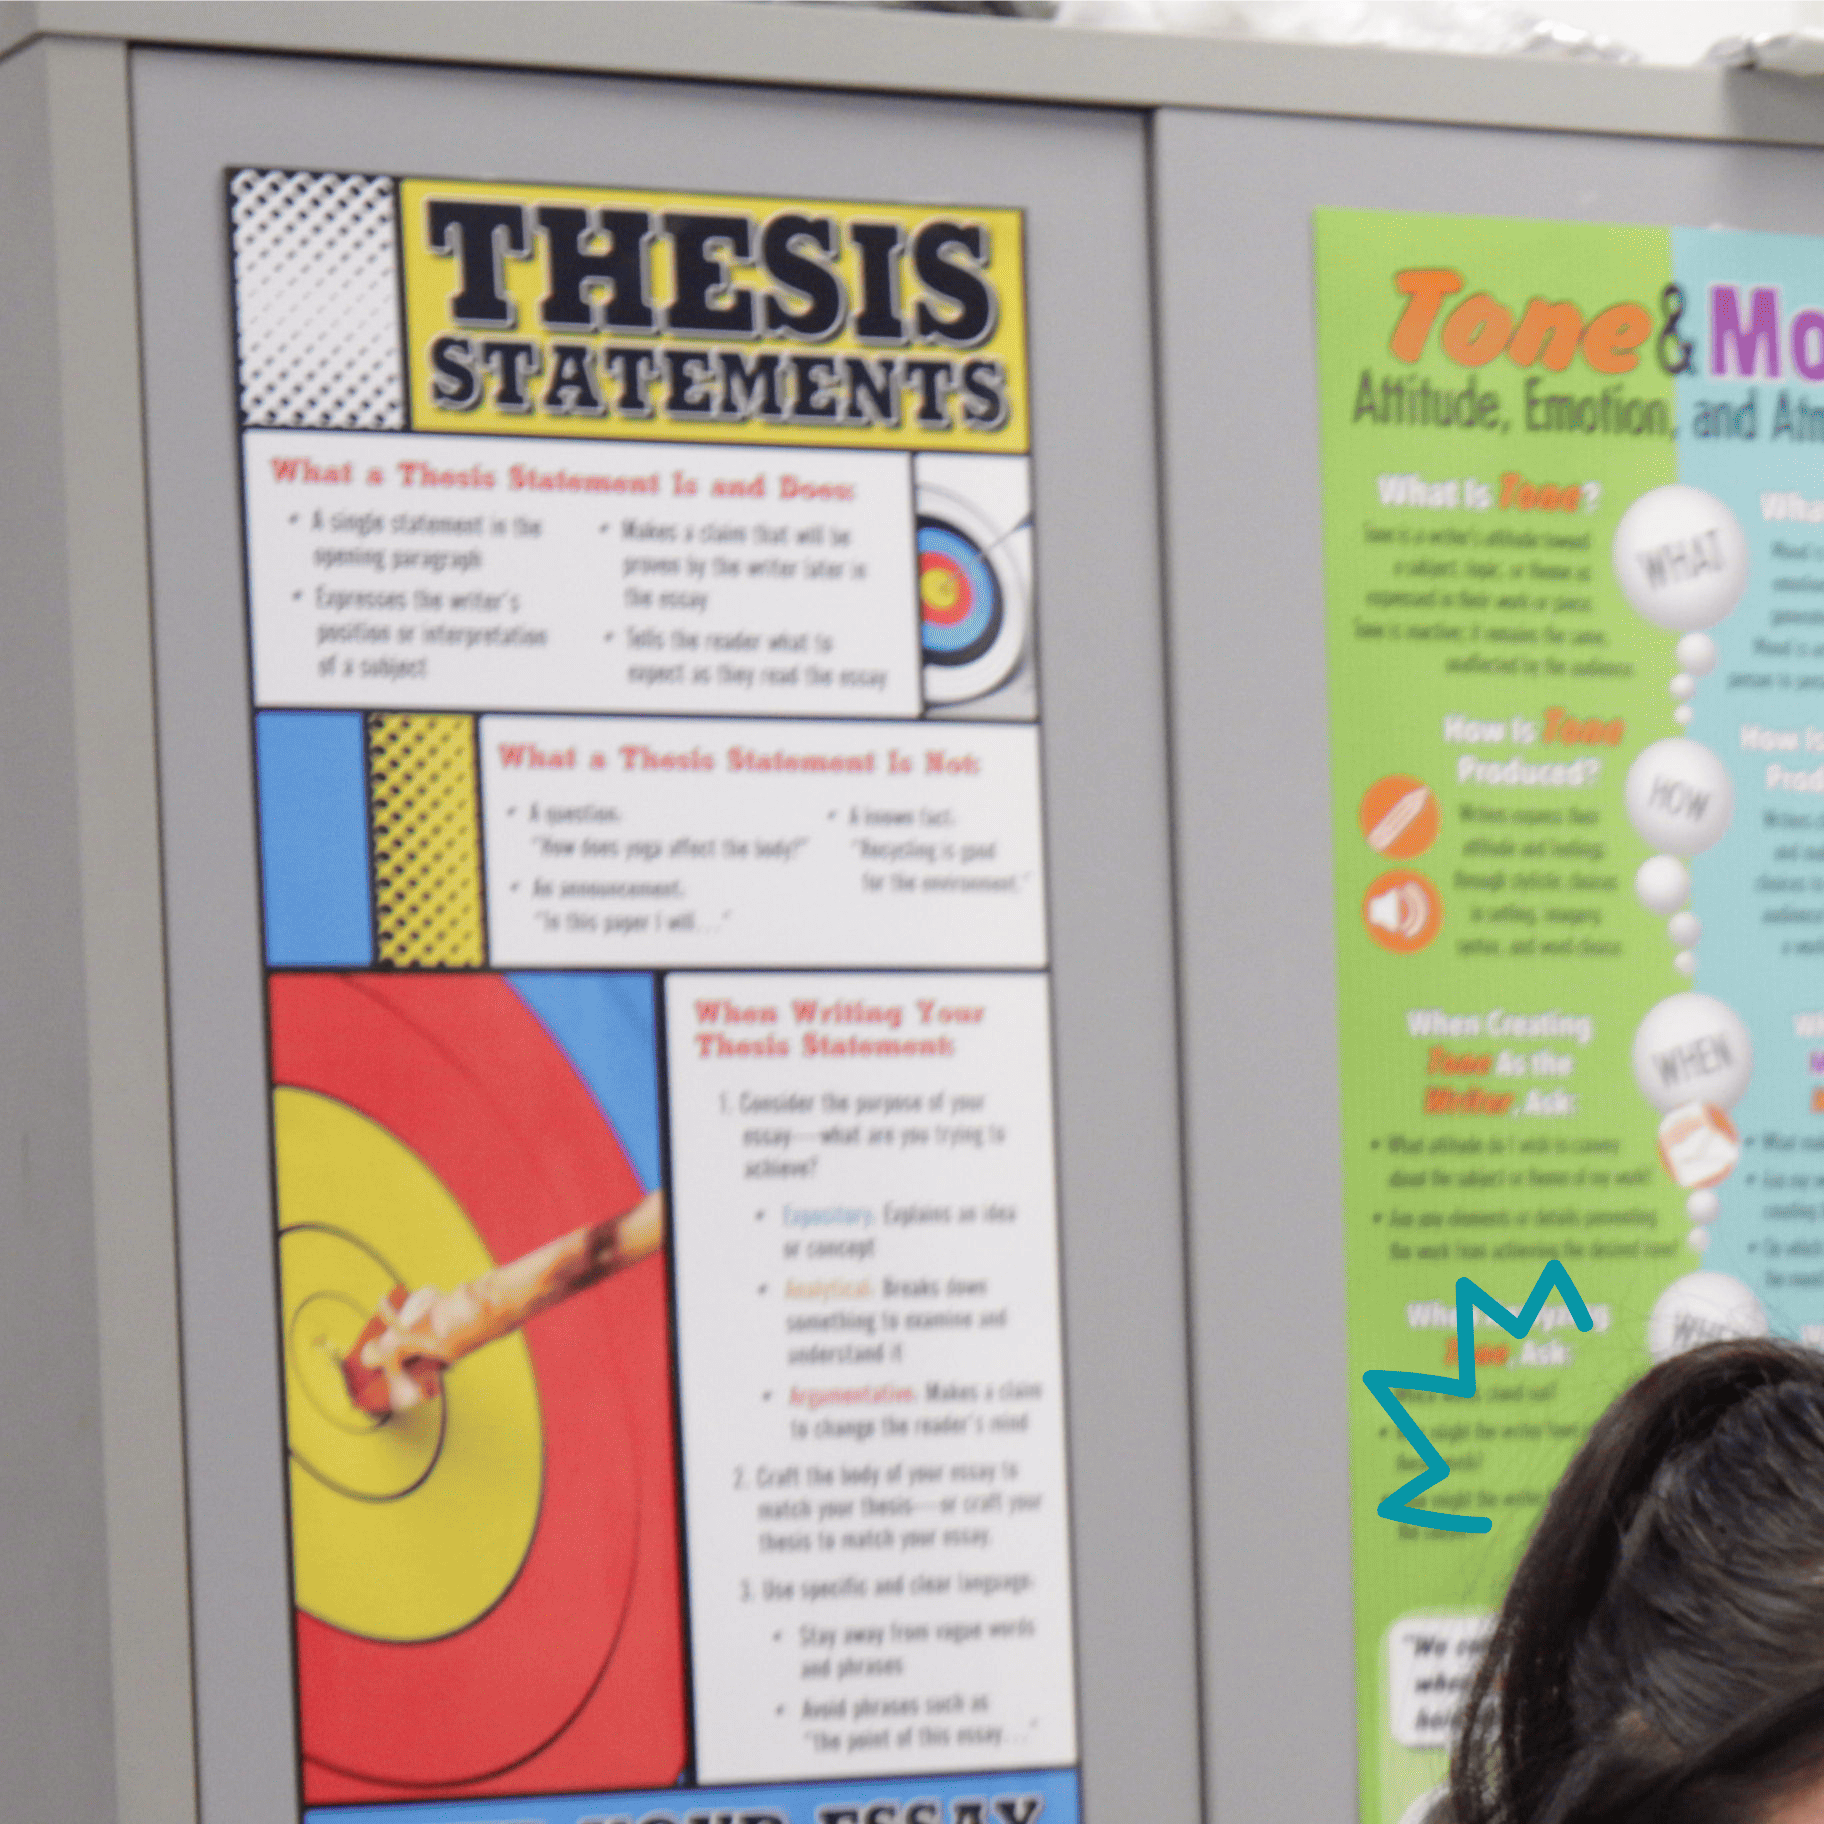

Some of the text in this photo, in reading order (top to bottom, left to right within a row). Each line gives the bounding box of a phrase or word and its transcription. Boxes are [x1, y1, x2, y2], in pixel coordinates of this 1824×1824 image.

[425, 198, 999, 347] THESIS
[1389, 267, 1653, 374] Tone
[1657, 281, 1694, 375] &
[429, 337, 1008, 429] STATEMENTS
[1352, 367, 1511, 433] Attitude,
[1524, 376, 1680, 443] Emotion,
[1692, 386, 1758, 441] and
[270, 457, 352, 484] What
[365, 468, 385, 486] a
[397, 460, 495, 487] Thesis
[508, 463, 659, 492] Statement
[673, 470, 698, 496] Is
[712, 474, 765, 498] and
[1378, 474, 1457, 507] What
[1465, 478, 1490, 510] Is
[331, 513, 384, 537] single
[391, 514, 483, 534] statement
[513, 517, 542, 537] the
[314, 548, 482, 574] opening paragraph
[1635, 528, 1727, 592] WHAT
[315, 585, 406, 613] Expresses
[413, 590, 442, 611] the
[317, 623, 390, 646] position
[422, 624, 548, 648] interpretation
[1444, 705, 1626, 746] How Is Tone
[1740, 723, 1799, 751] How
[498, 744, 575, 769] What
[590, 754, 606, 769] a
[618, 745, 714, 770] Thesis
[726, 745, 875, 773] Statement
[888, 749, 912, 773] Is
[1458, 754, 1600, 786] Produced?
[1649, 776, 1711, 821] HOW
[582, 838, 618, 858] does
[626, 842, 662, 862] yoga
[669, 838, 715, 858] affect
[722, 838, 748, 858] the
[694, 998, 984, 1029] When Writing Your
[1406, 1009, 1592, 1045] When Creating
[695, 1032, 790, 1058] Thesis
[1653, 1030, 1734, 1088] WHEN
[1495, 1049, 1526, 1076] As
[1530, 1049, 1573, 1076] the
[740, 1091, 814, 1114] Consider
[821, 1092, 847, 1113] the
[856, 1096, 922, 1117] purpose
[929, 1091, 944, 1112] of
[951, 1094, 984, 1115] your
[868, 1127, 894, 1145] are
[901, 1128, 928, 1149] you
[936, 1124, 983, 1149] trying
[882, 1203, 950, 1226] Explains
[983, 1203, 1017, 1223] idea
[807, 1238, 875, 1260] concept
[801, 1619, 1035, 1649] Stay away from vague words
[802, 1656, 903, 1681] and phrases
